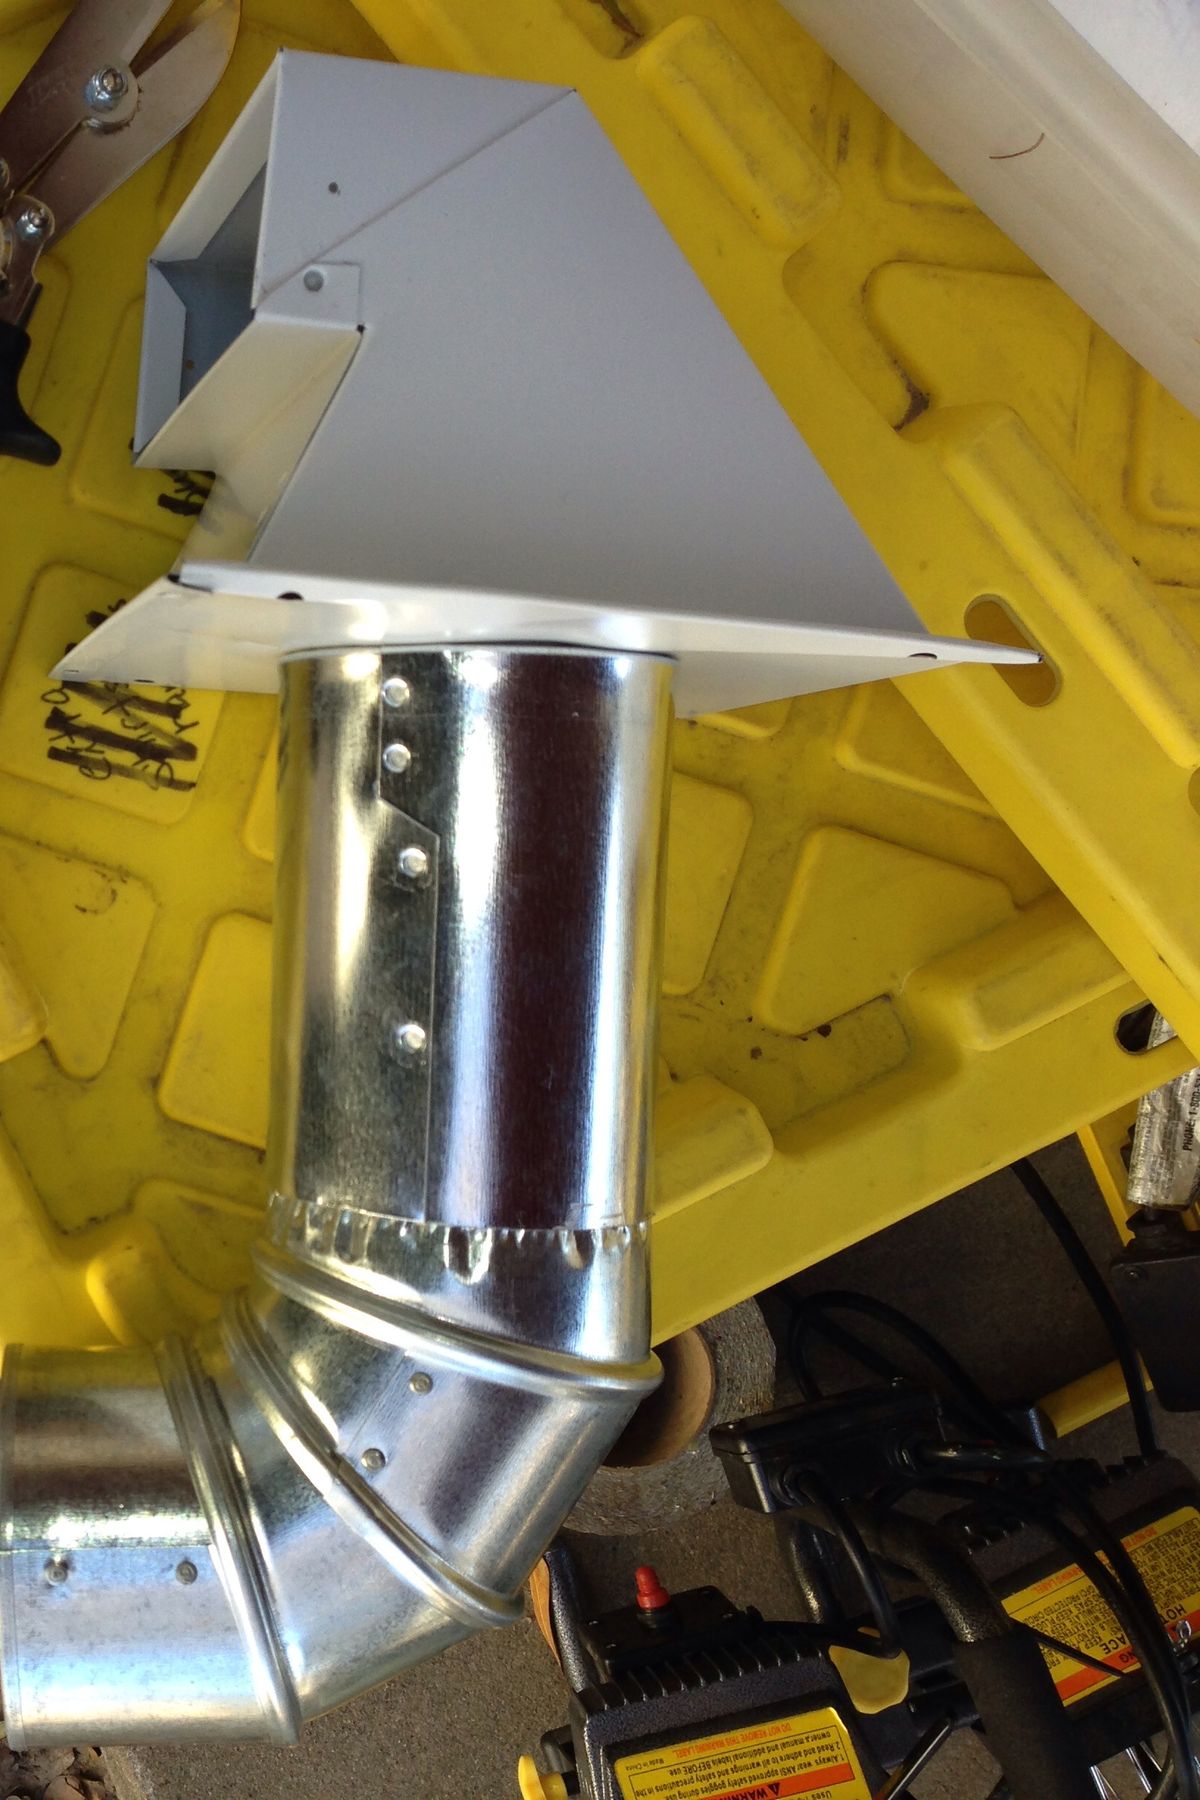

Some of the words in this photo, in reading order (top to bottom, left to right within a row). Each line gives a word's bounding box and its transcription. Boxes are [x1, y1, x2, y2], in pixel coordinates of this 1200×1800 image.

[766, 1743, 779, 1754] and
[779, 1737, 804, 1750] manual
[732, 1746, 766, 1762] additional
[778, 1750, 802, 1763] adhere
[802, 1747, 816, 1757] and
[682, 1760, 711, 1775] BEFORE
[716, 1768, 729, 1778] and
[729, 1758, 761, 1775] warnings
[694, 1769, 716, 1784] safety
[726, 1774, 748, 1789] safety
[747, 1767, 779, 1783] approved
